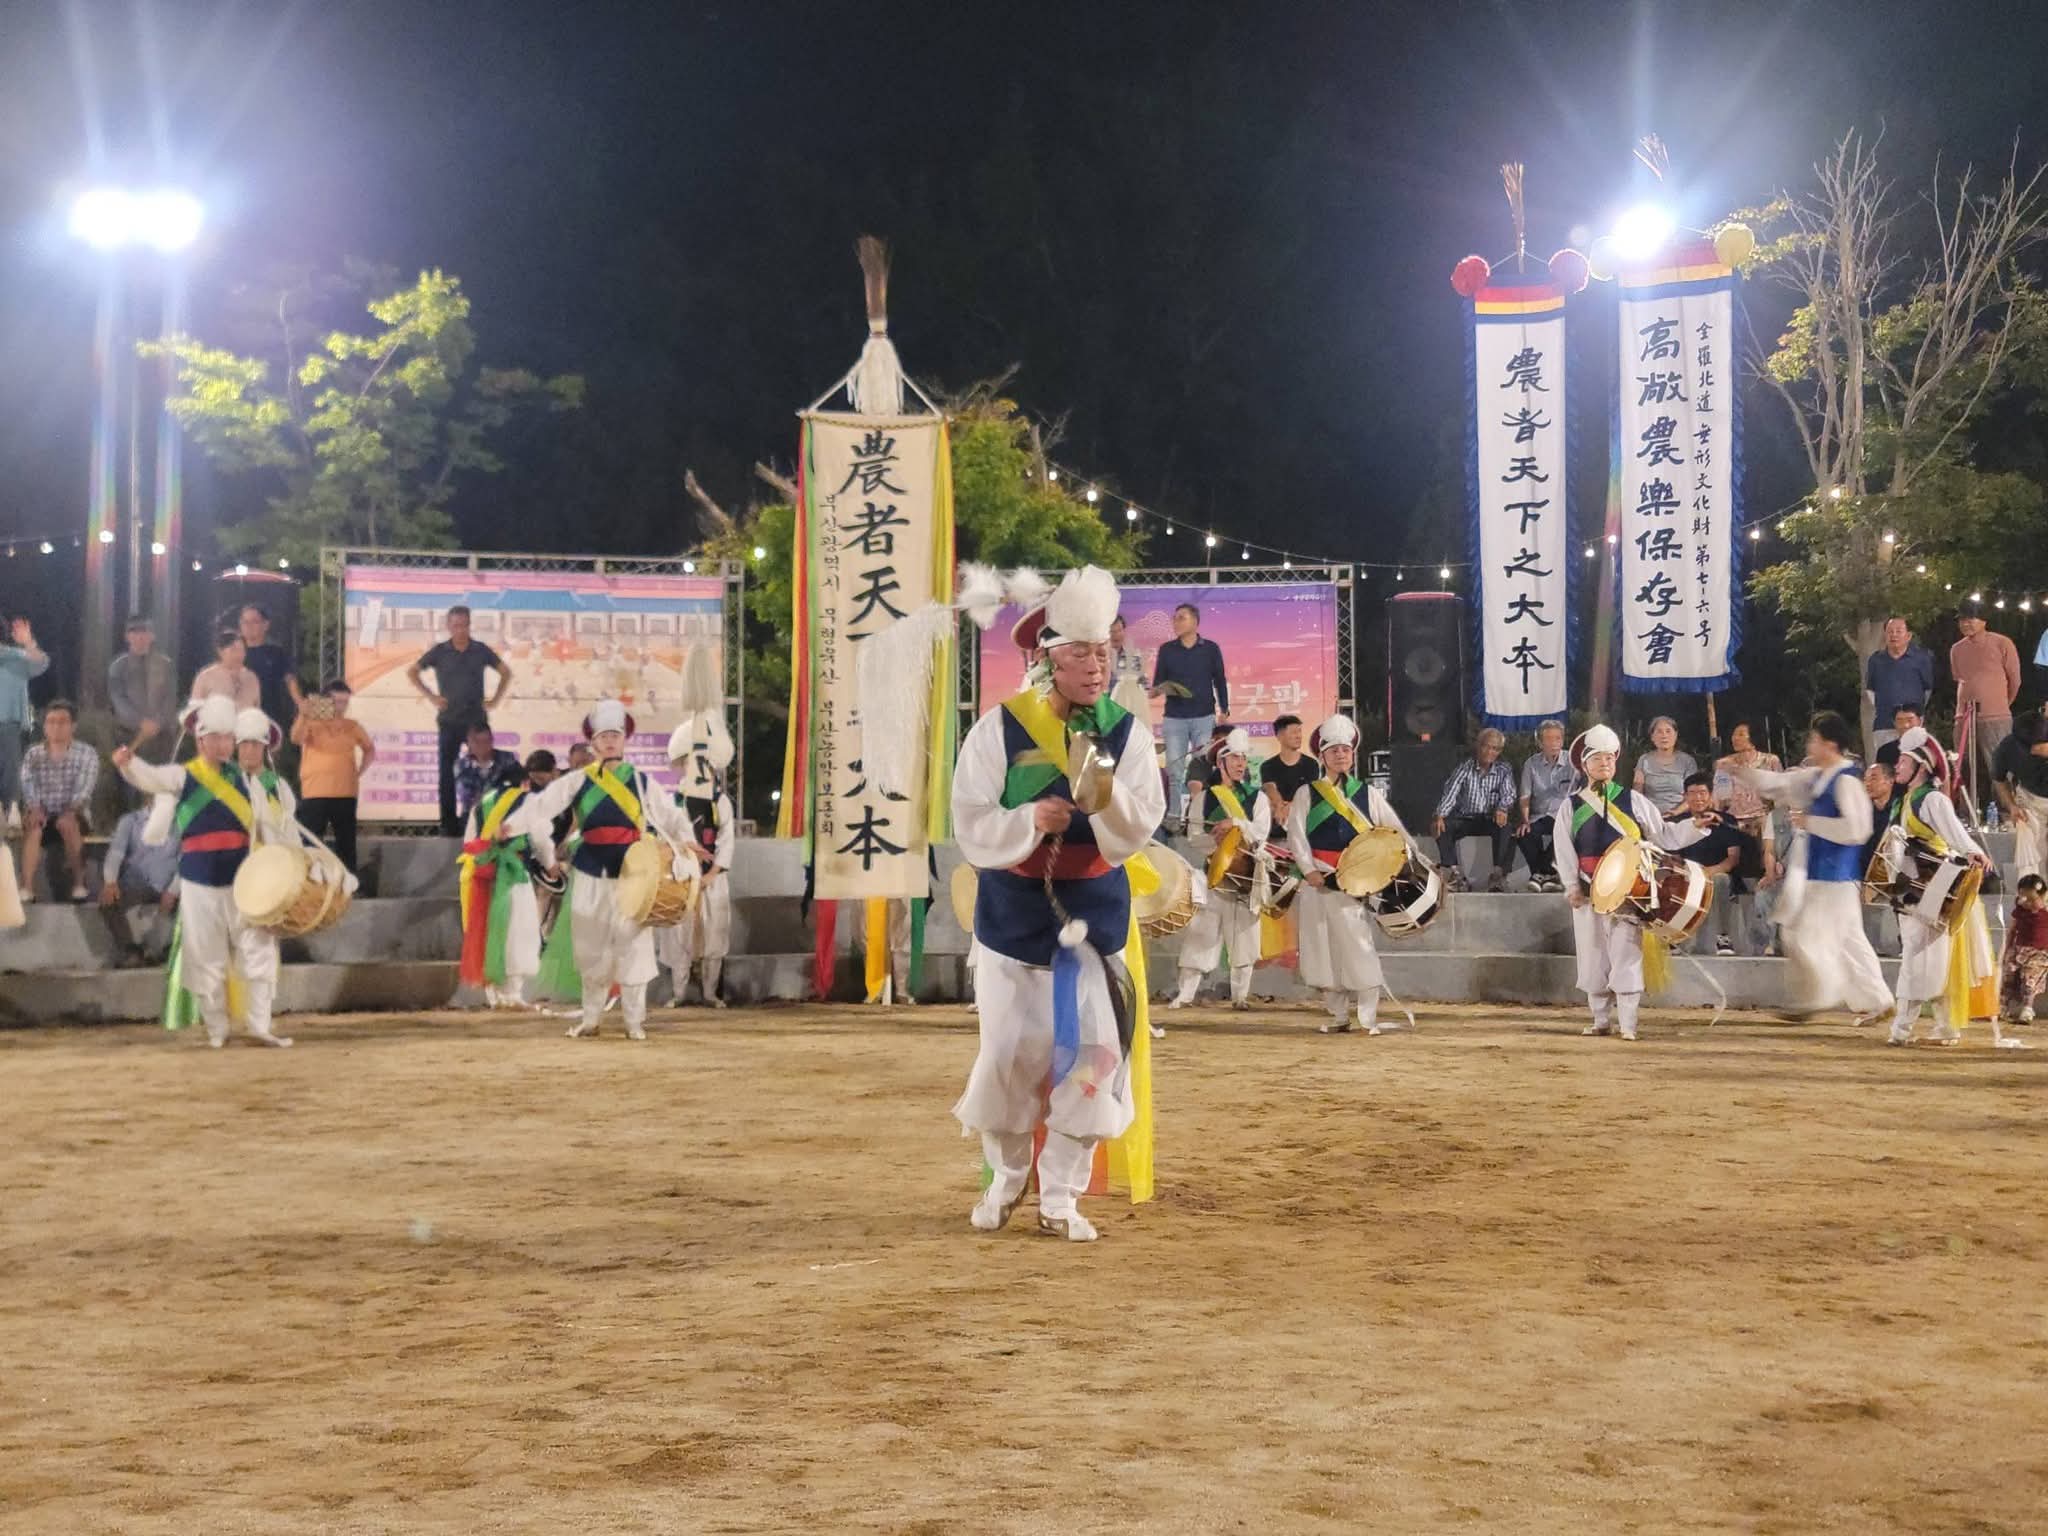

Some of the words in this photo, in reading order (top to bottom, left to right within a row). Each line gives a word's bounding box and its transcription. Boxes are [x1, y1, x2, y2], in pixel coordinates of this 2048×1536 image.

[836, 430, 912, 871] 農者天本
[1500, 347, 1555, 694] 農者天下之大本
